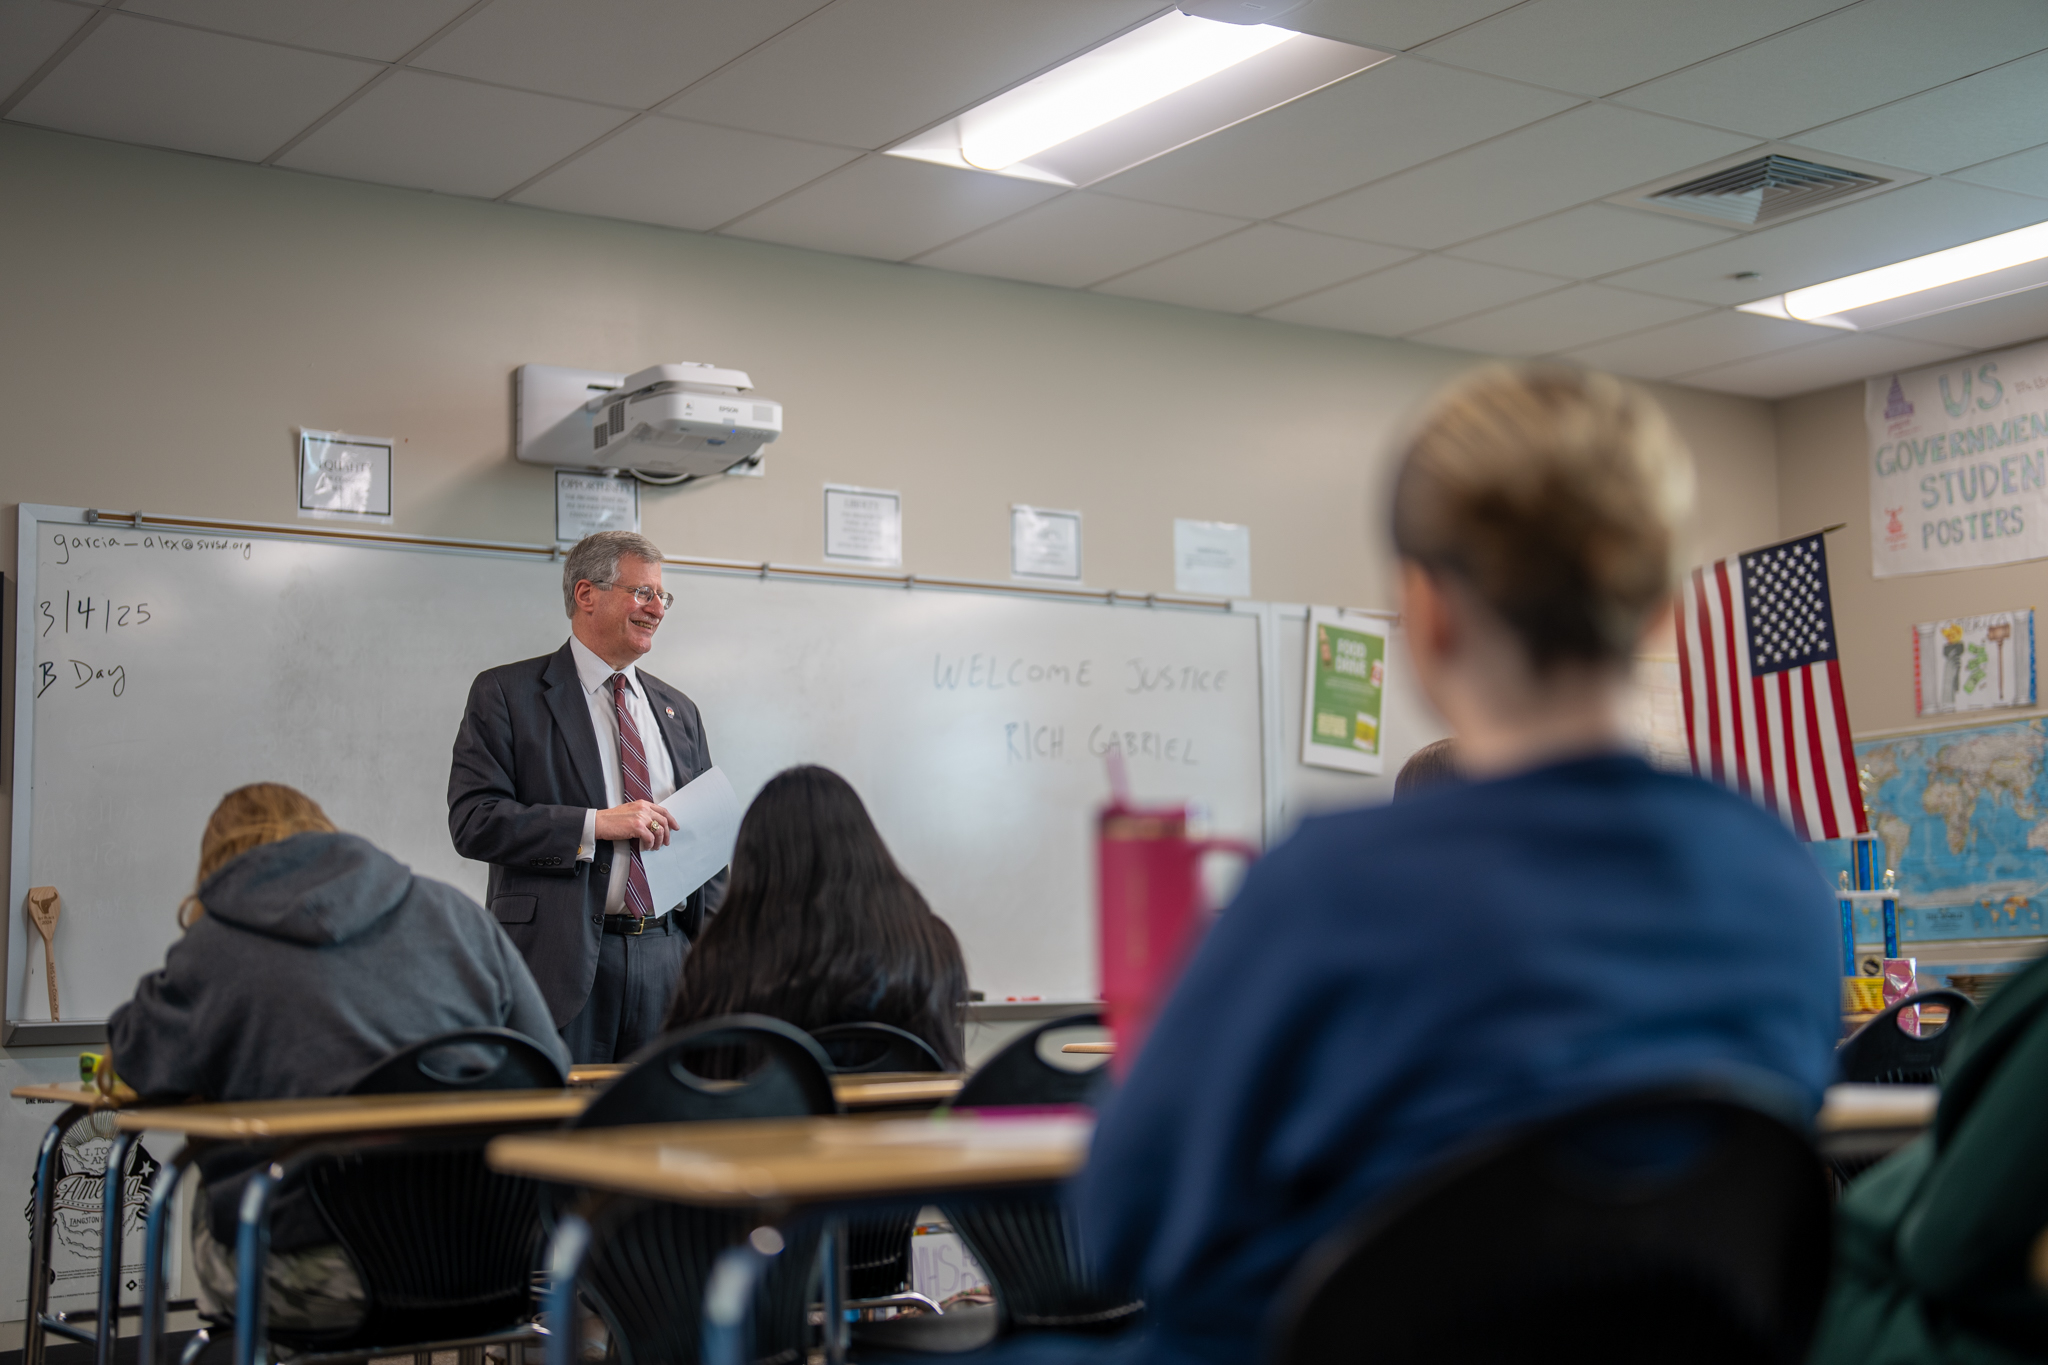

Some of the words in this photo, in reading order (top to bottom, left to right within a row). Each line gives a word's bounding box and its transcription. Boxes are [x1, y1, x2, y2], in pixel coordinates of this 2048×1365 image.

[718, 404, 739, 413] EPSON
[561, 477, 633, 493] OPPORTUNITY
[1920, 446, 2048, 511] STUDEN
[1921, 505, 2025, 551] POSTERS
[40, 590, 151, 637] 3/4/25
[37, 661, 57, 699] B
[68, 659, 126, 698] Day
[933, 652, 1093, 692] WELCOME
[1125, 656, 1229, 695] JUSTICE
[1004, 720, 1064, 767] RICH
[1087, 723, 1199, 766] GABRIEL
[1905, 1019, 1915, 1035] Red
[25, 1097, 36, 1105] ONE
[57, 1175, 140, 1201] Ameca
[914, 1244, 960, 1297] NHS
